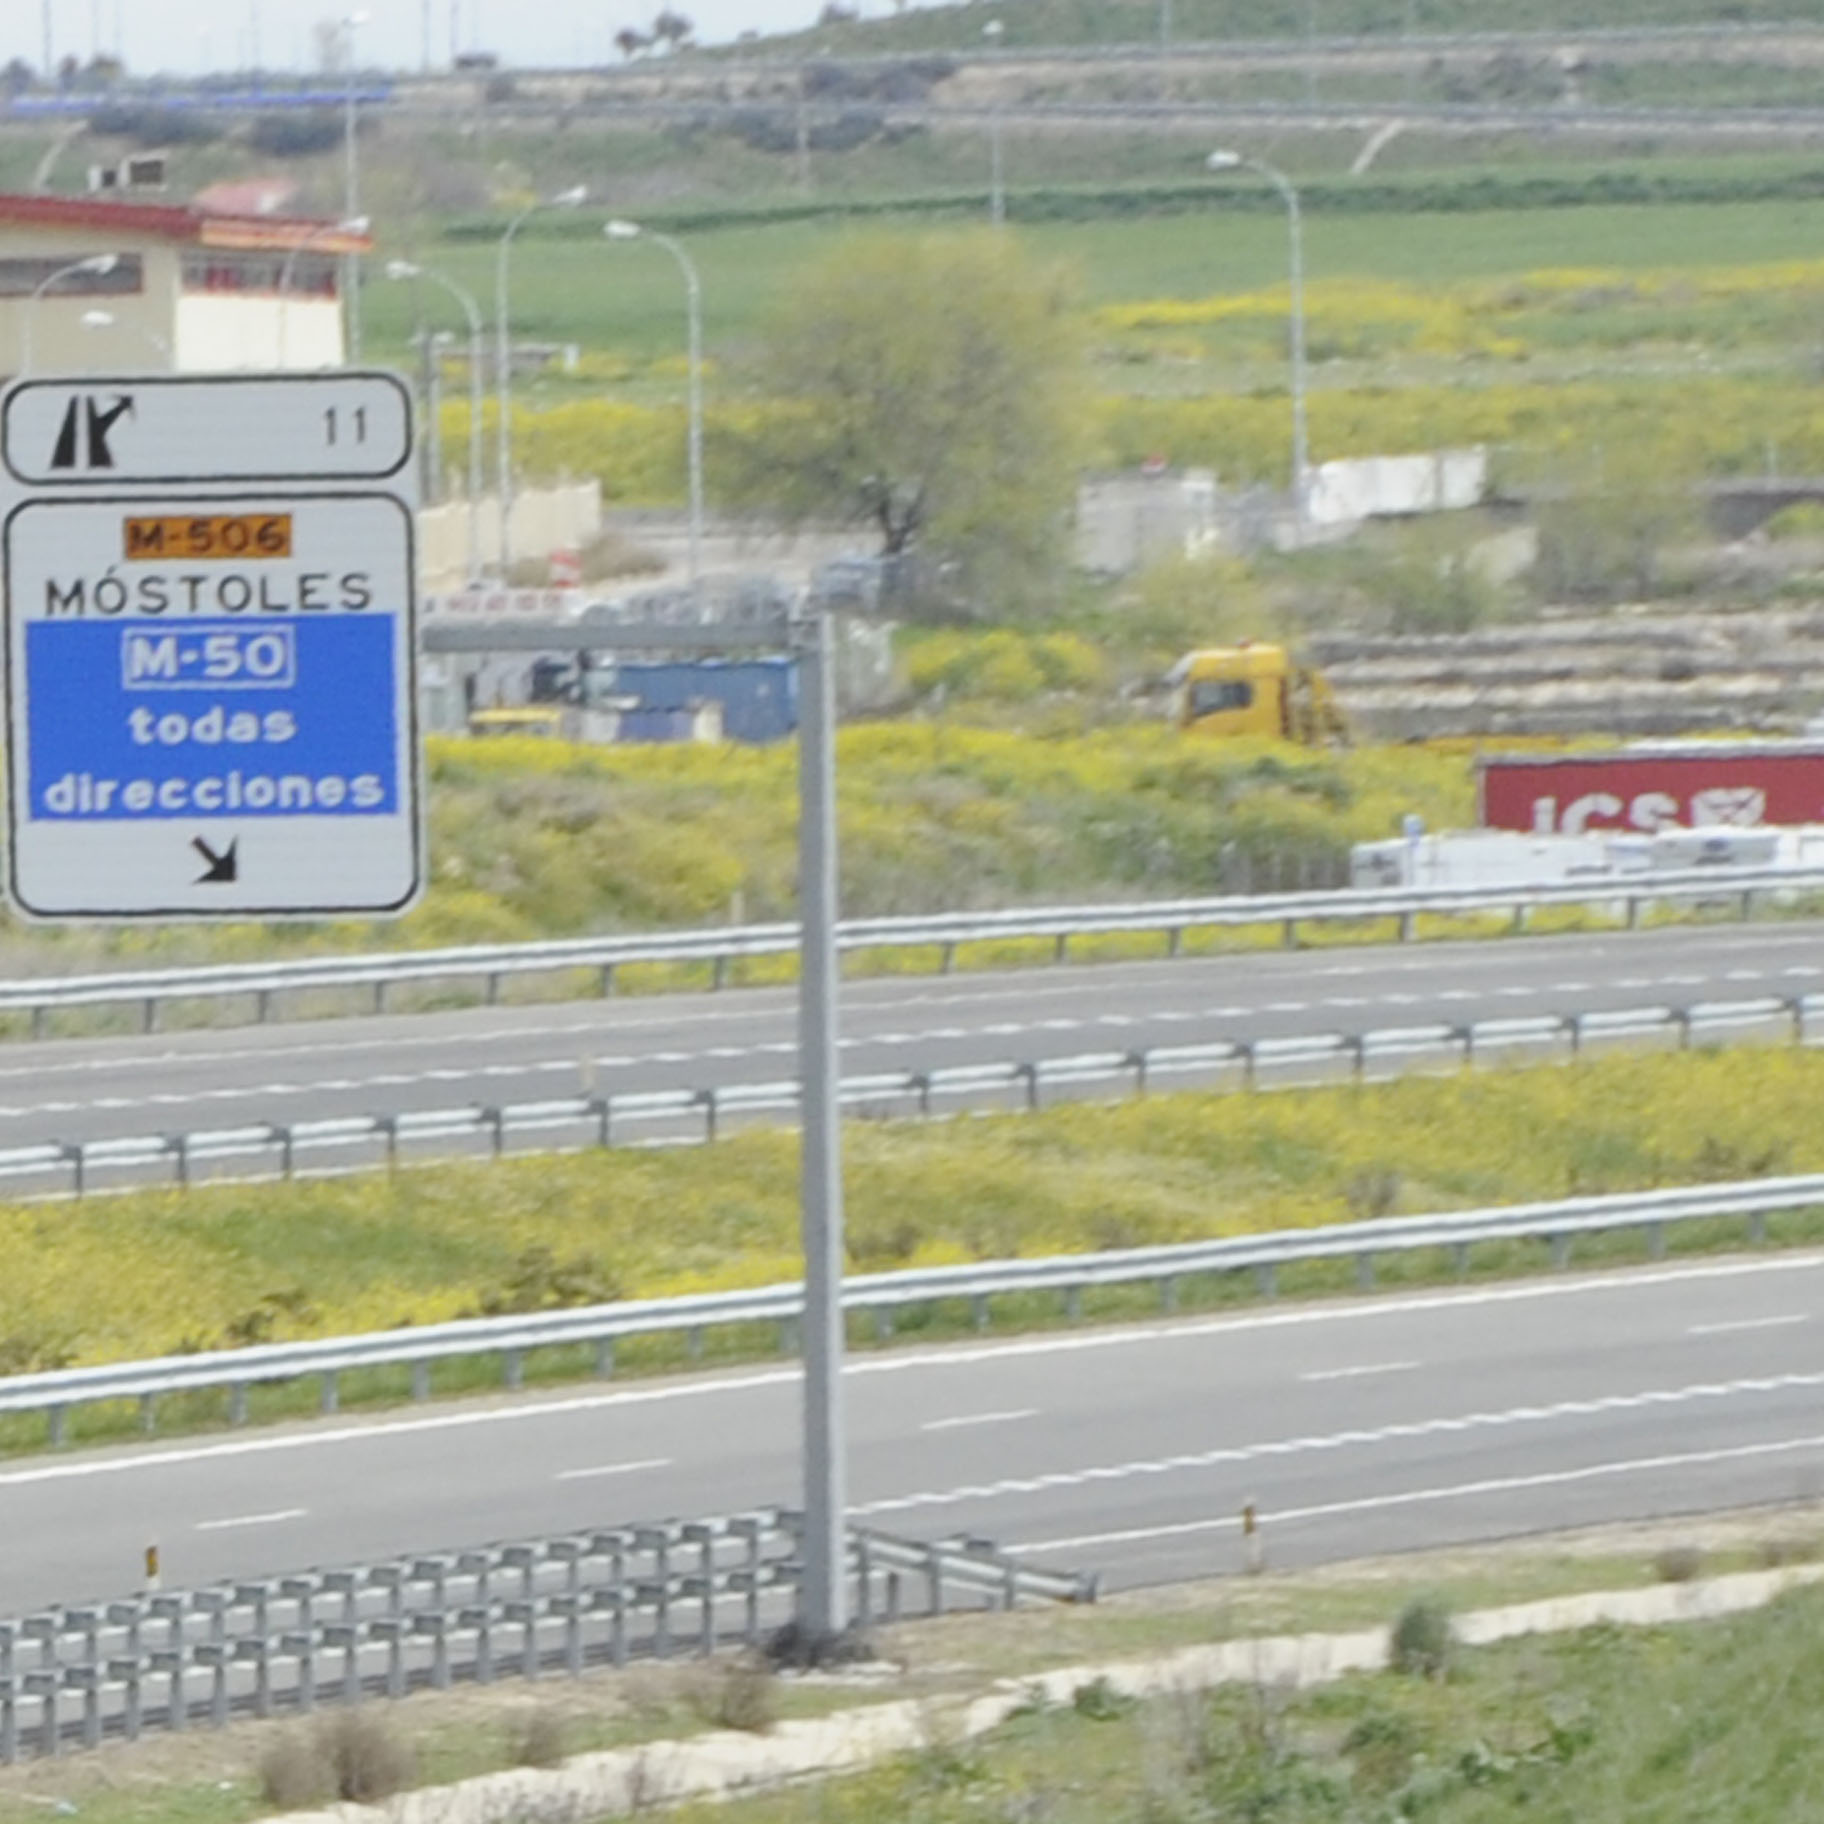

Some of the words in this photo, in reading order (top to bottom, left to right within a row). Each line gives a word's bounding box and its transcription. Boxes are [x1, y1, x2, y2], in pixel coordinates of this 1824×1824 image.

[323, 405, 366, 446] 11
[127, 519, 288, 556] M-506
[45, 566, 373, 616] MÓSTOLES
[129, 634, 287, 679] M-50
[128, 706, 297, 744] todas
[44, 771, 386, 813] direcciones
